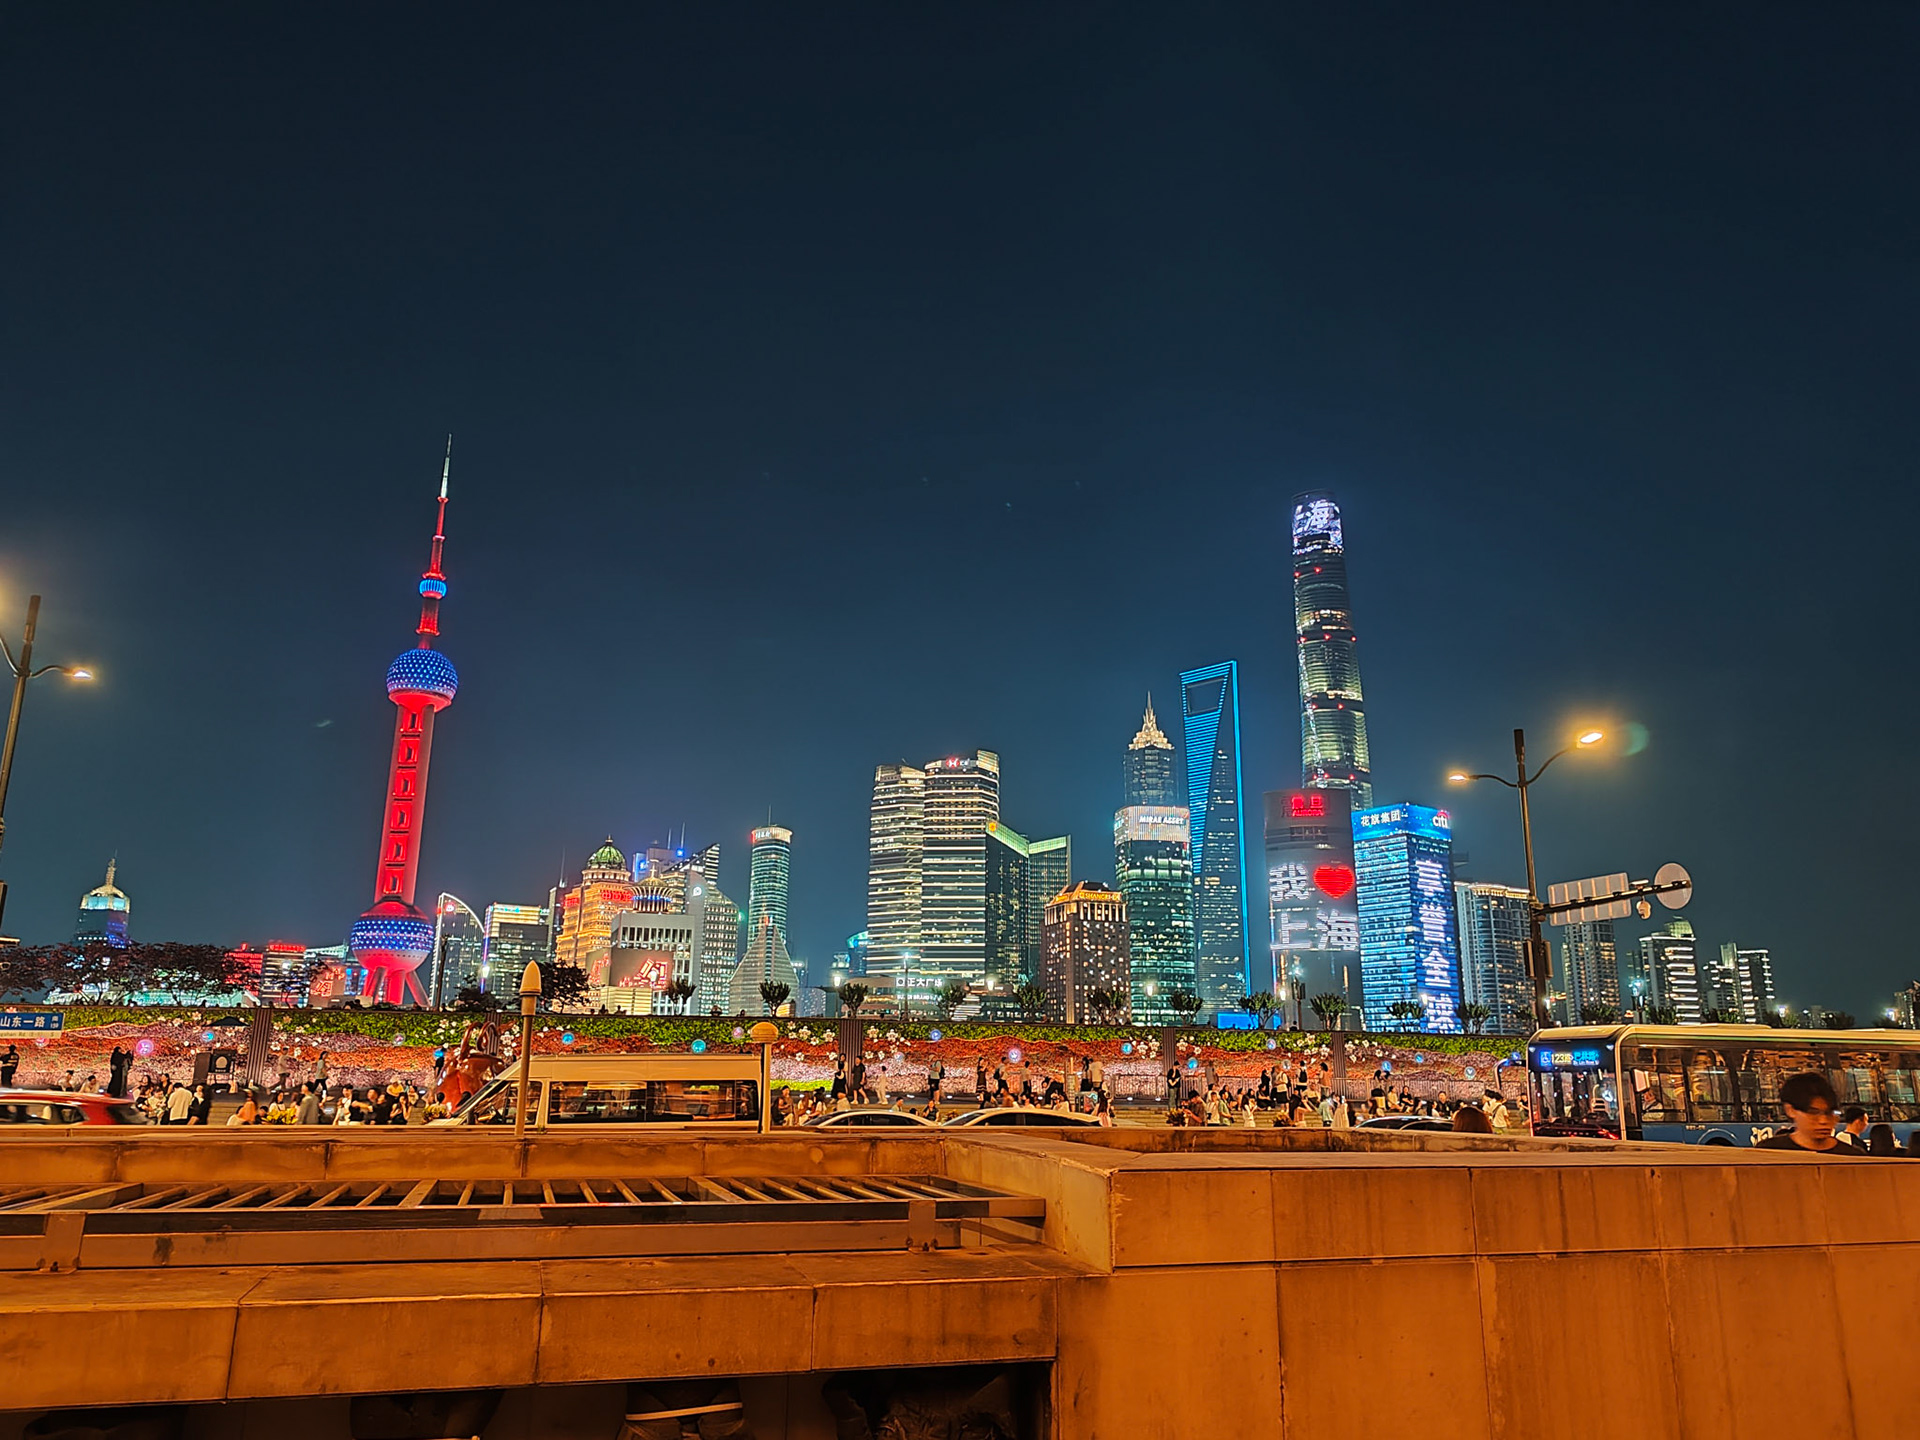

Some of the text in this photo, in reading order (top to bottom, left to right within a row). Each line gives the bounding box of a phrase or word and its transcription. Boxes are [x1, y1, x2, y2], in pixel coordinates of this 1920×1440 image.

[1140, 815, 1184, 825] MIRAE ASSET
[1360, 809, 1400, 827] 花旗集团
[1432, 814, 1449, 829] citi
[1269, 862, 1311, 902] 我
[1269, 908, 1359, 951] 上海
[907, 978, 943, 987] 正大广场
[0, 1015, 45, 1028] 山东一路
